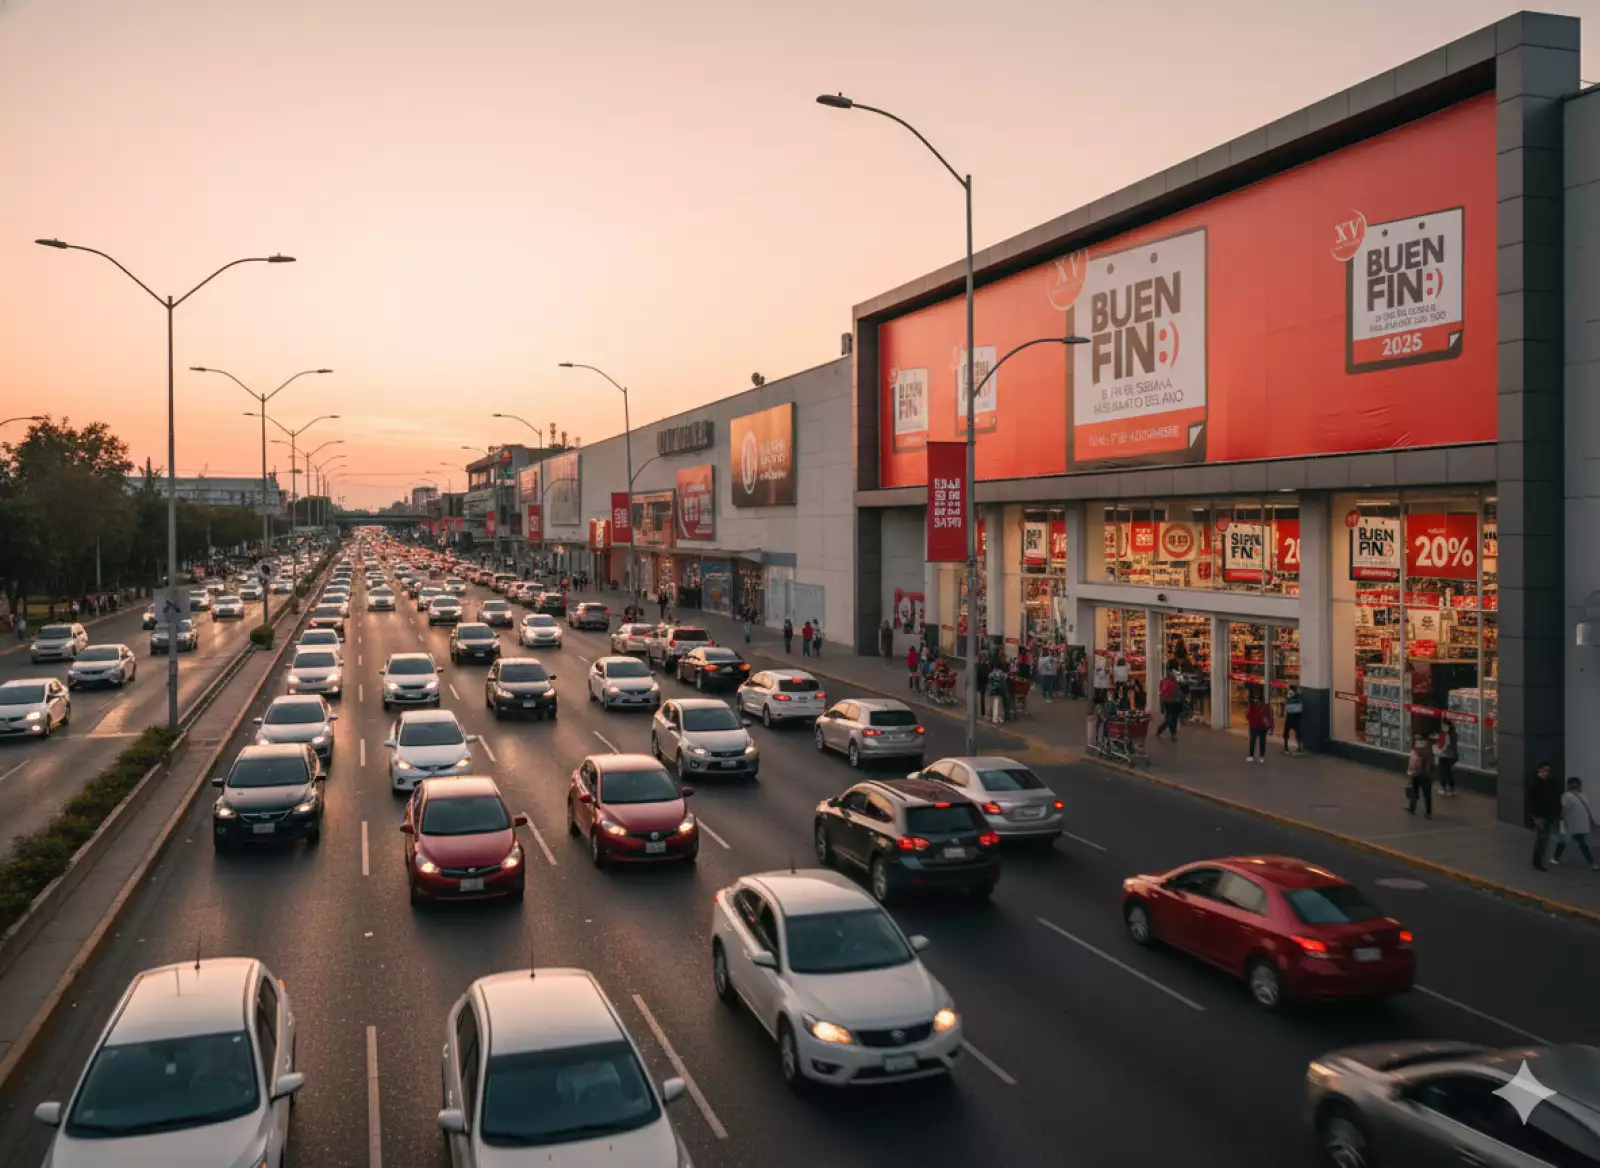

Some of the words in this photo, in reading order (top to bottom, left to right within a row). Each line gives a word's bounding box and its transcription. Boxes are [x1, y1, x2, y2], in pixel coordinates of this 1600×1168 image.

[1367, 234, 1444, 277] BUEN
[1091, 270, 1181, 333] BUEN
[1382, 333, 1423, 356] 2025
[1415, 535, 1474, 568] 20%
